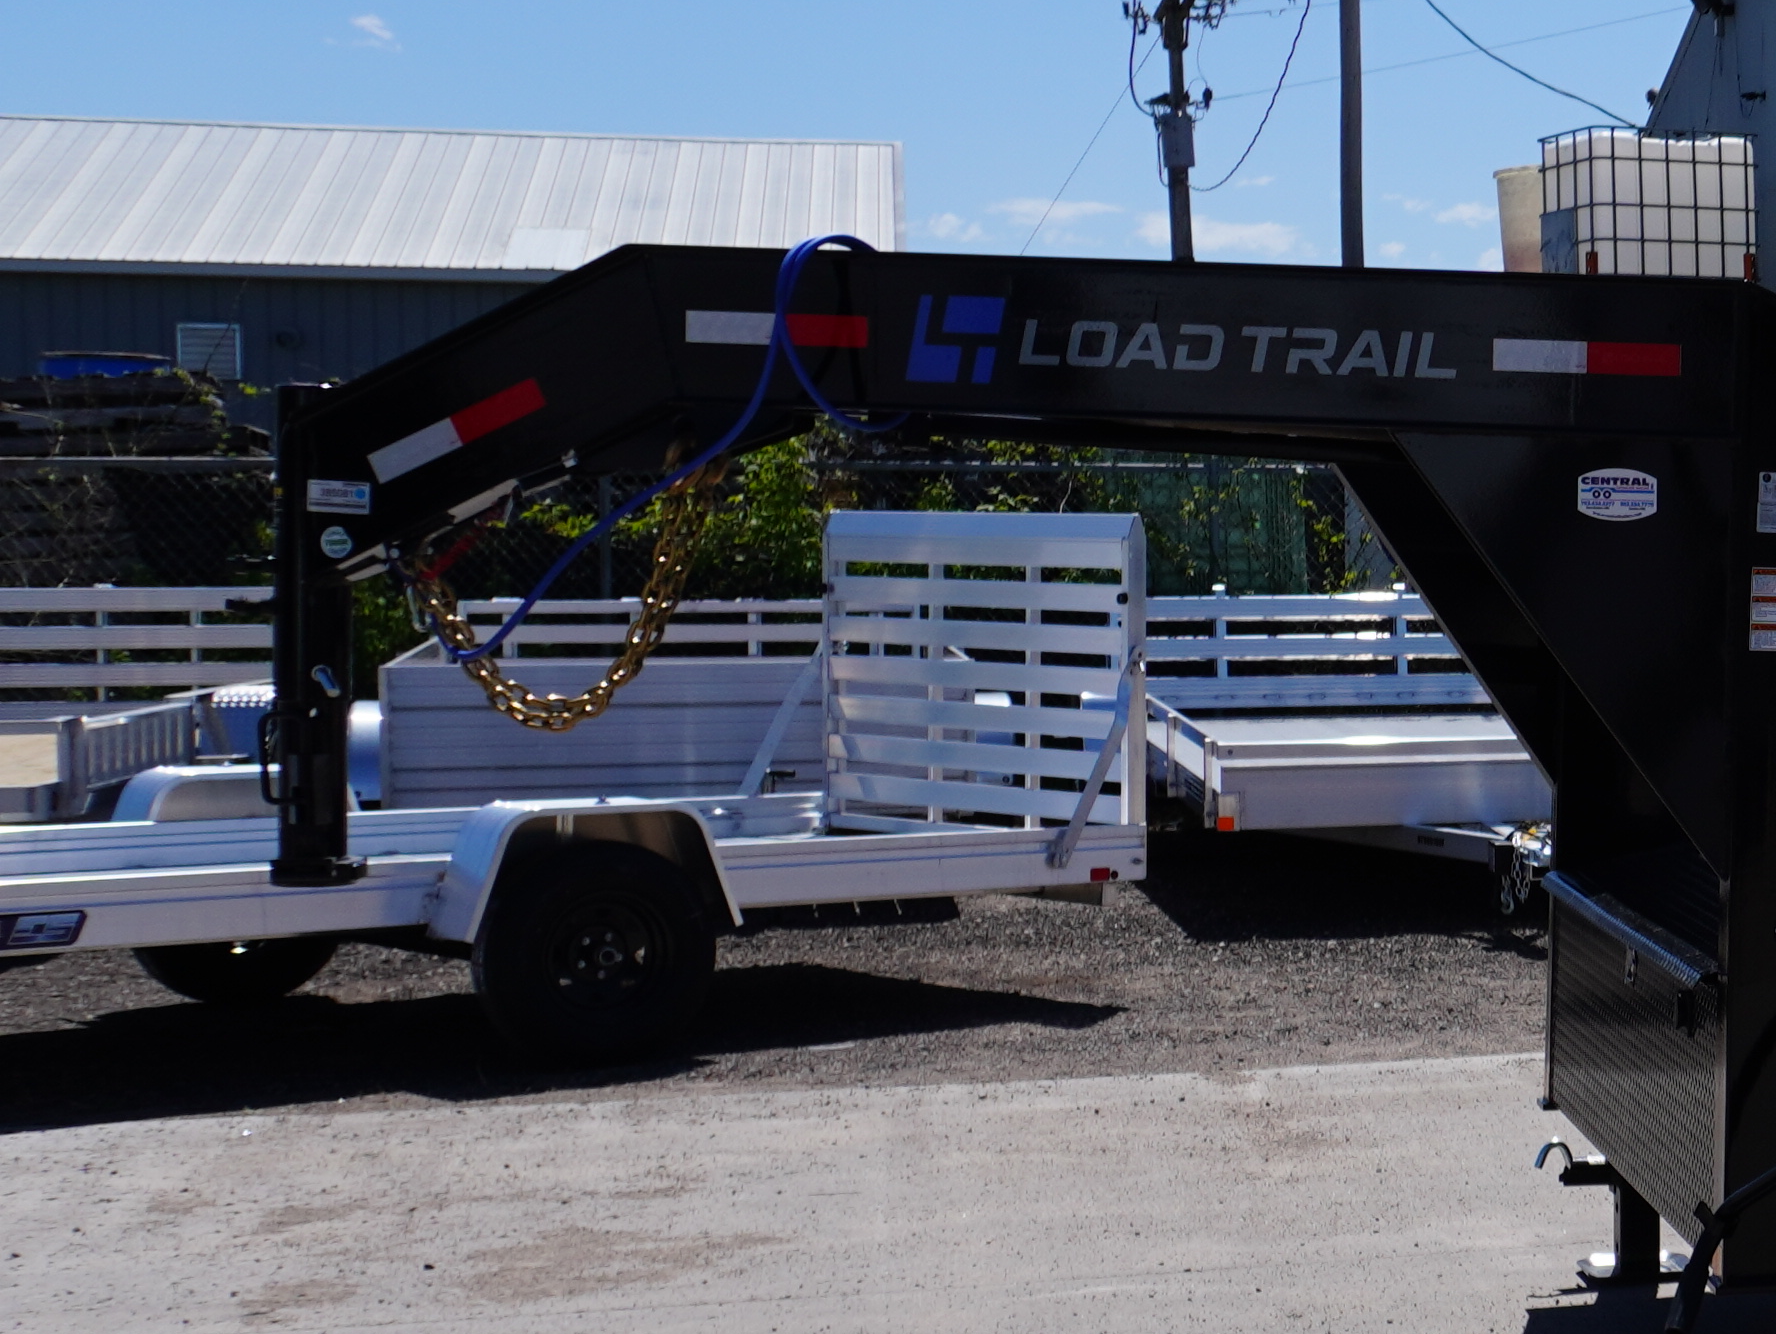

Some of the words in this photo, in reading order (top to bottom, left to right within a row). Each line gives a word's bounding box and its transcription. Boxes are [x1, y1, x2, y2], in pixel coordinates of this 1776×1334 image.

[1017, 318, 1226, 372] LOAD
[1241, 324, 1458, 380] TRAIL
[1581, 476, 1649, 486] CENTRAL
